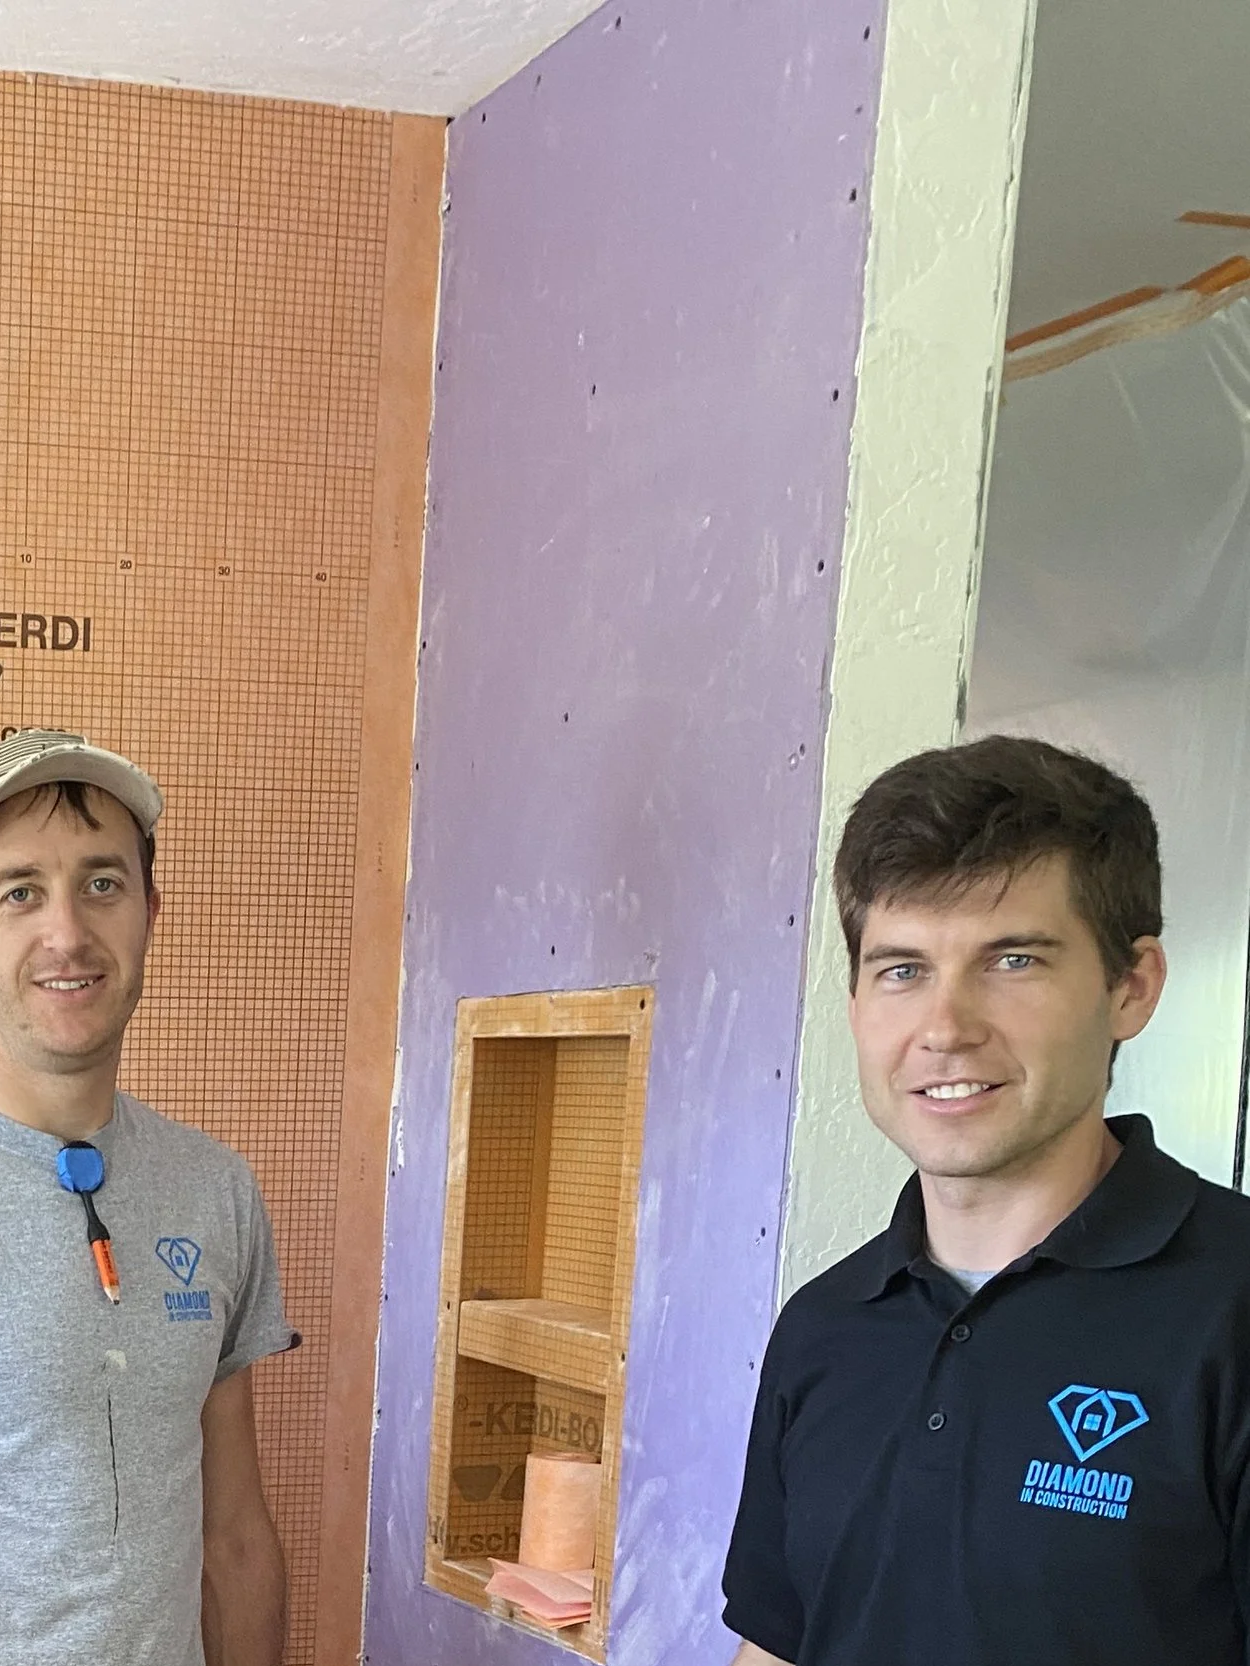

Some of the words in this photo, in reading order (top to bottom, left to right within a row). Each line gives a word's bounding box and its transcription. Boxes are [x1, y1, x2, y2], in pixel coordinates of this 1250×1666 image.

[20, 555, 32, 563] 10
[120, 560, 132, 569] 20
[218, 566, 230, 576] 30
[315, 572, 327, 581] 40
[164, 1289, 210, 1310] DIAMOND
[1024, 1459, 1133, 1503] DIAMOND
[1019, 1487, 1034, 1503] IN
[1035, 1490, 1128, 1520] CONSTRUCTION
